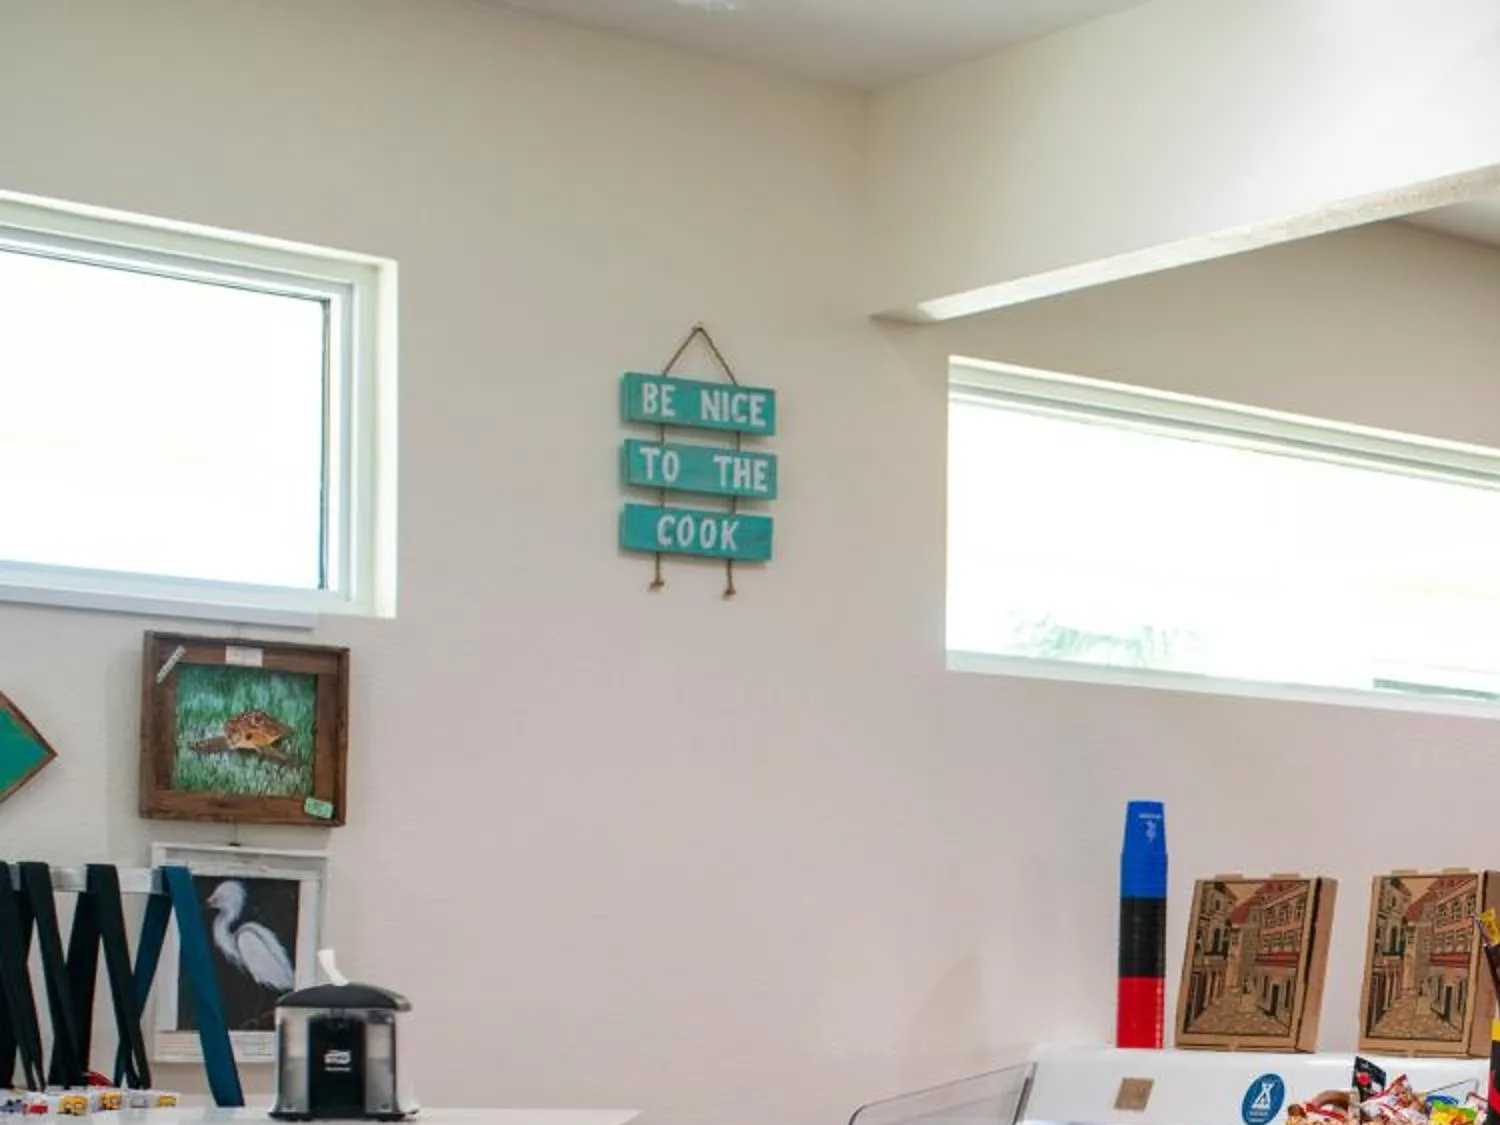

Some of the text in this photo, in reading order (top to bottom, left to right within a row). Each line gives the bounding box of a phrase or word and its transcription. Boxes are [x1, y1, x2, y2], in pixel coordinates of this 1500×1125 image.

[641, 382, 767, 428] BE NICE
[639, 446, 768, 492] TO THE
[656, 514, 740, 551] COOK
